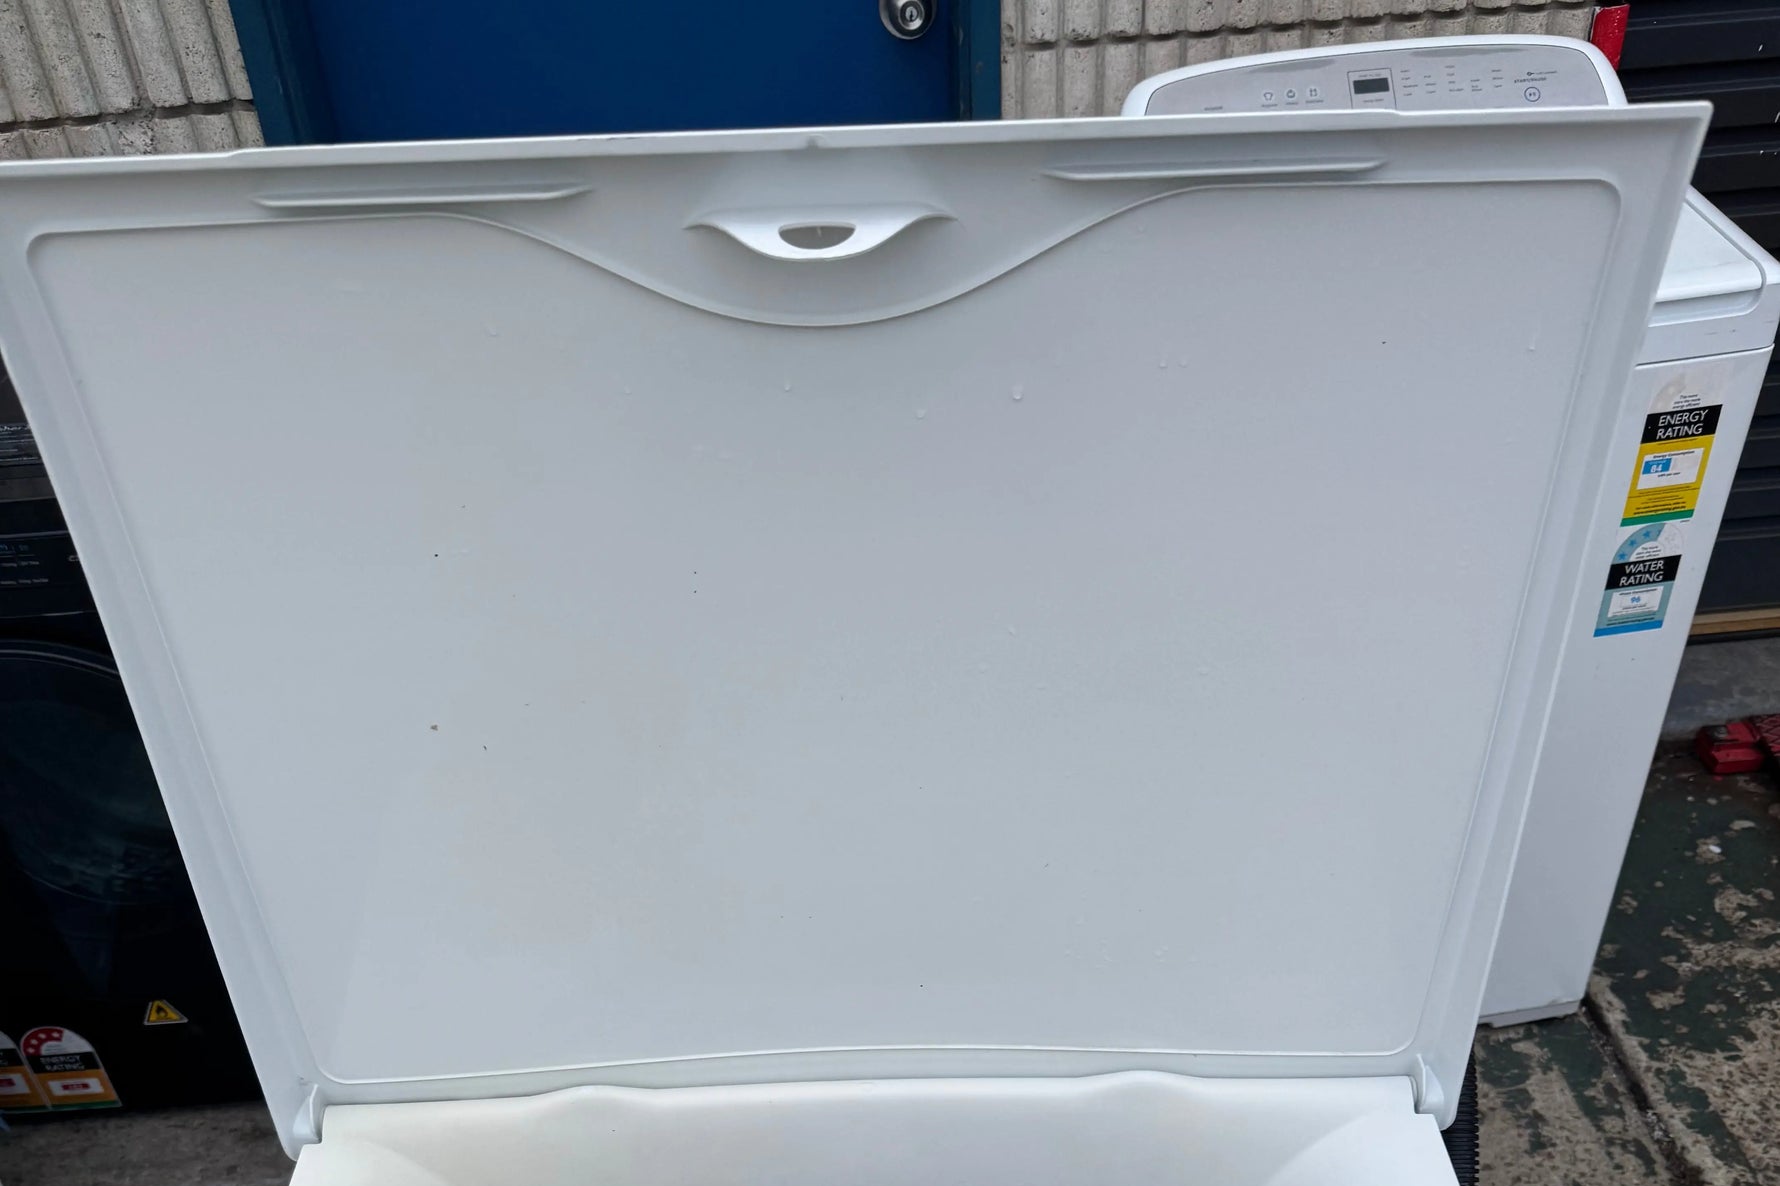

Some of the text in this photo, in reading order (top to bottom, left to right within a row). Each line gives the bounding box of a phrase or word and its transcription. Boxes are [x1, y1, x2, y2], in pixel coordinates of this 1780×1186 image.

[1658, 408, 1709, 427] ENERGY
[1656, 423, 1704, 440] RATING
[1625, 560, 1665, 575] WATER
[1619, 571, 1664, 587] RATING
